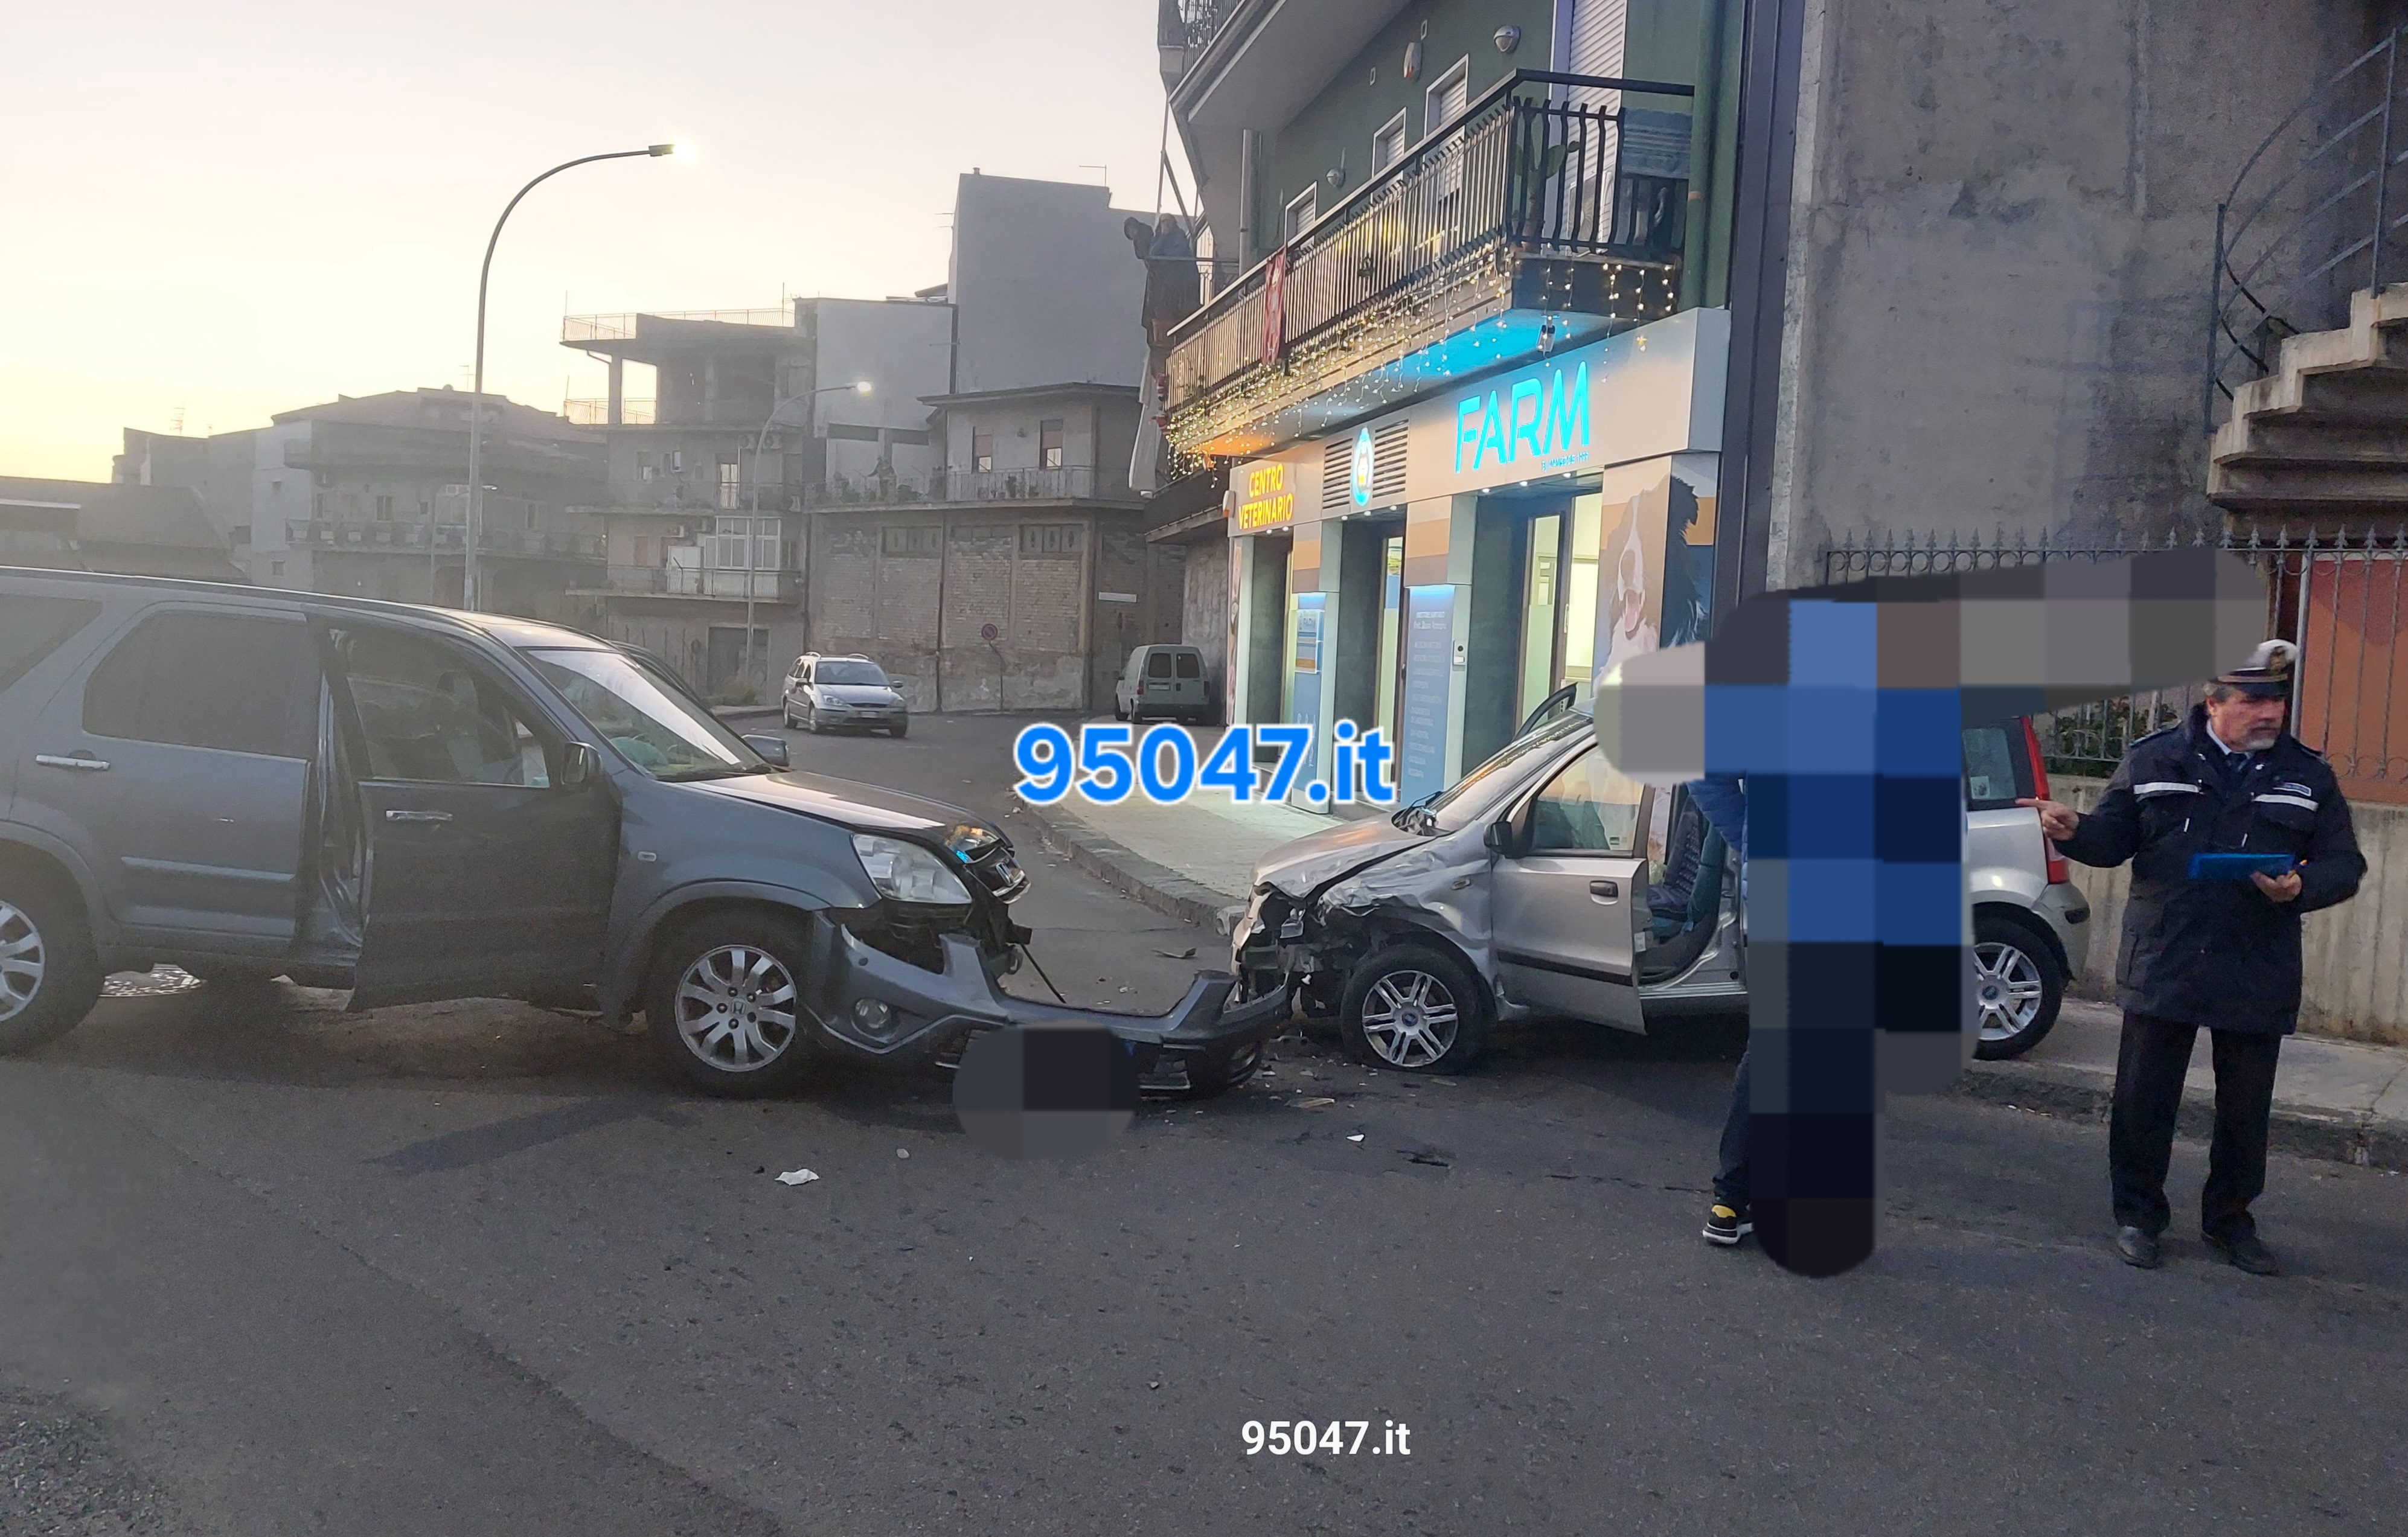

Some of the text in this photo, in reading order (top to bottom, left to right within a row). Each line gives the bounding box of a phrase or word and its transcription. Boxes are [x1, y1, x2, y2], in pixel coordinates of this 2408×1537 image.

[1456, 361, 1589, 473] FARM
[1249, 463, 1284, 498] CENTRO
[1238, 493, 1293, 530] VETERINARIO
